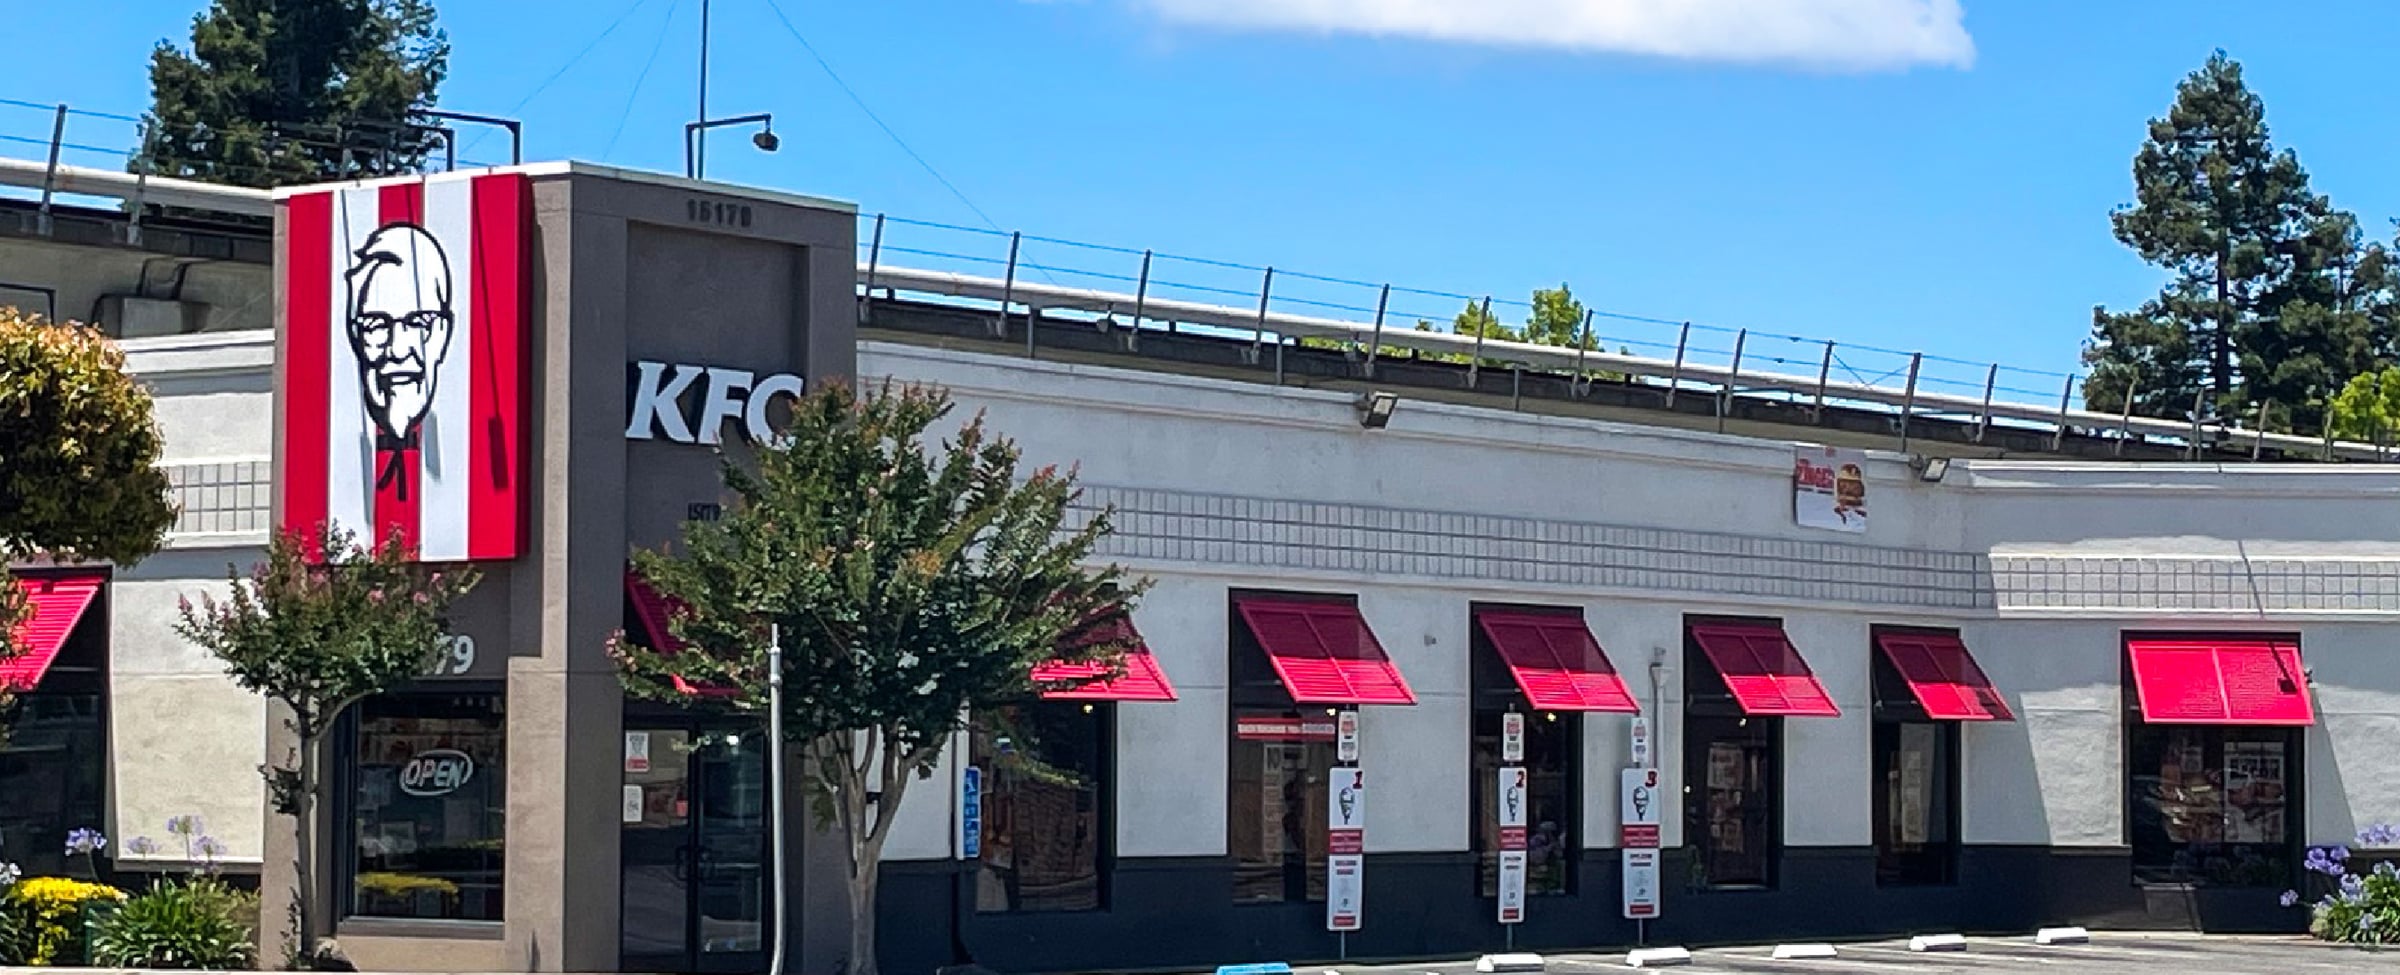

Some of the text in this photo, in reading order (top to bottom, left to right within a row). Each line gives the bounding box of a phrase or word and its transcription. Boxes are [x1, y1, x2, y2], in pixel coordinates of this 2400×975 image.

[625, 360, 805, 453] KFC
[404, 758, 466, 788] OPEN
[1352, 770, 1363, 789] 1
[1515, 770, 1525, 788] 2
[1644, 770, 1658, 788] 3
